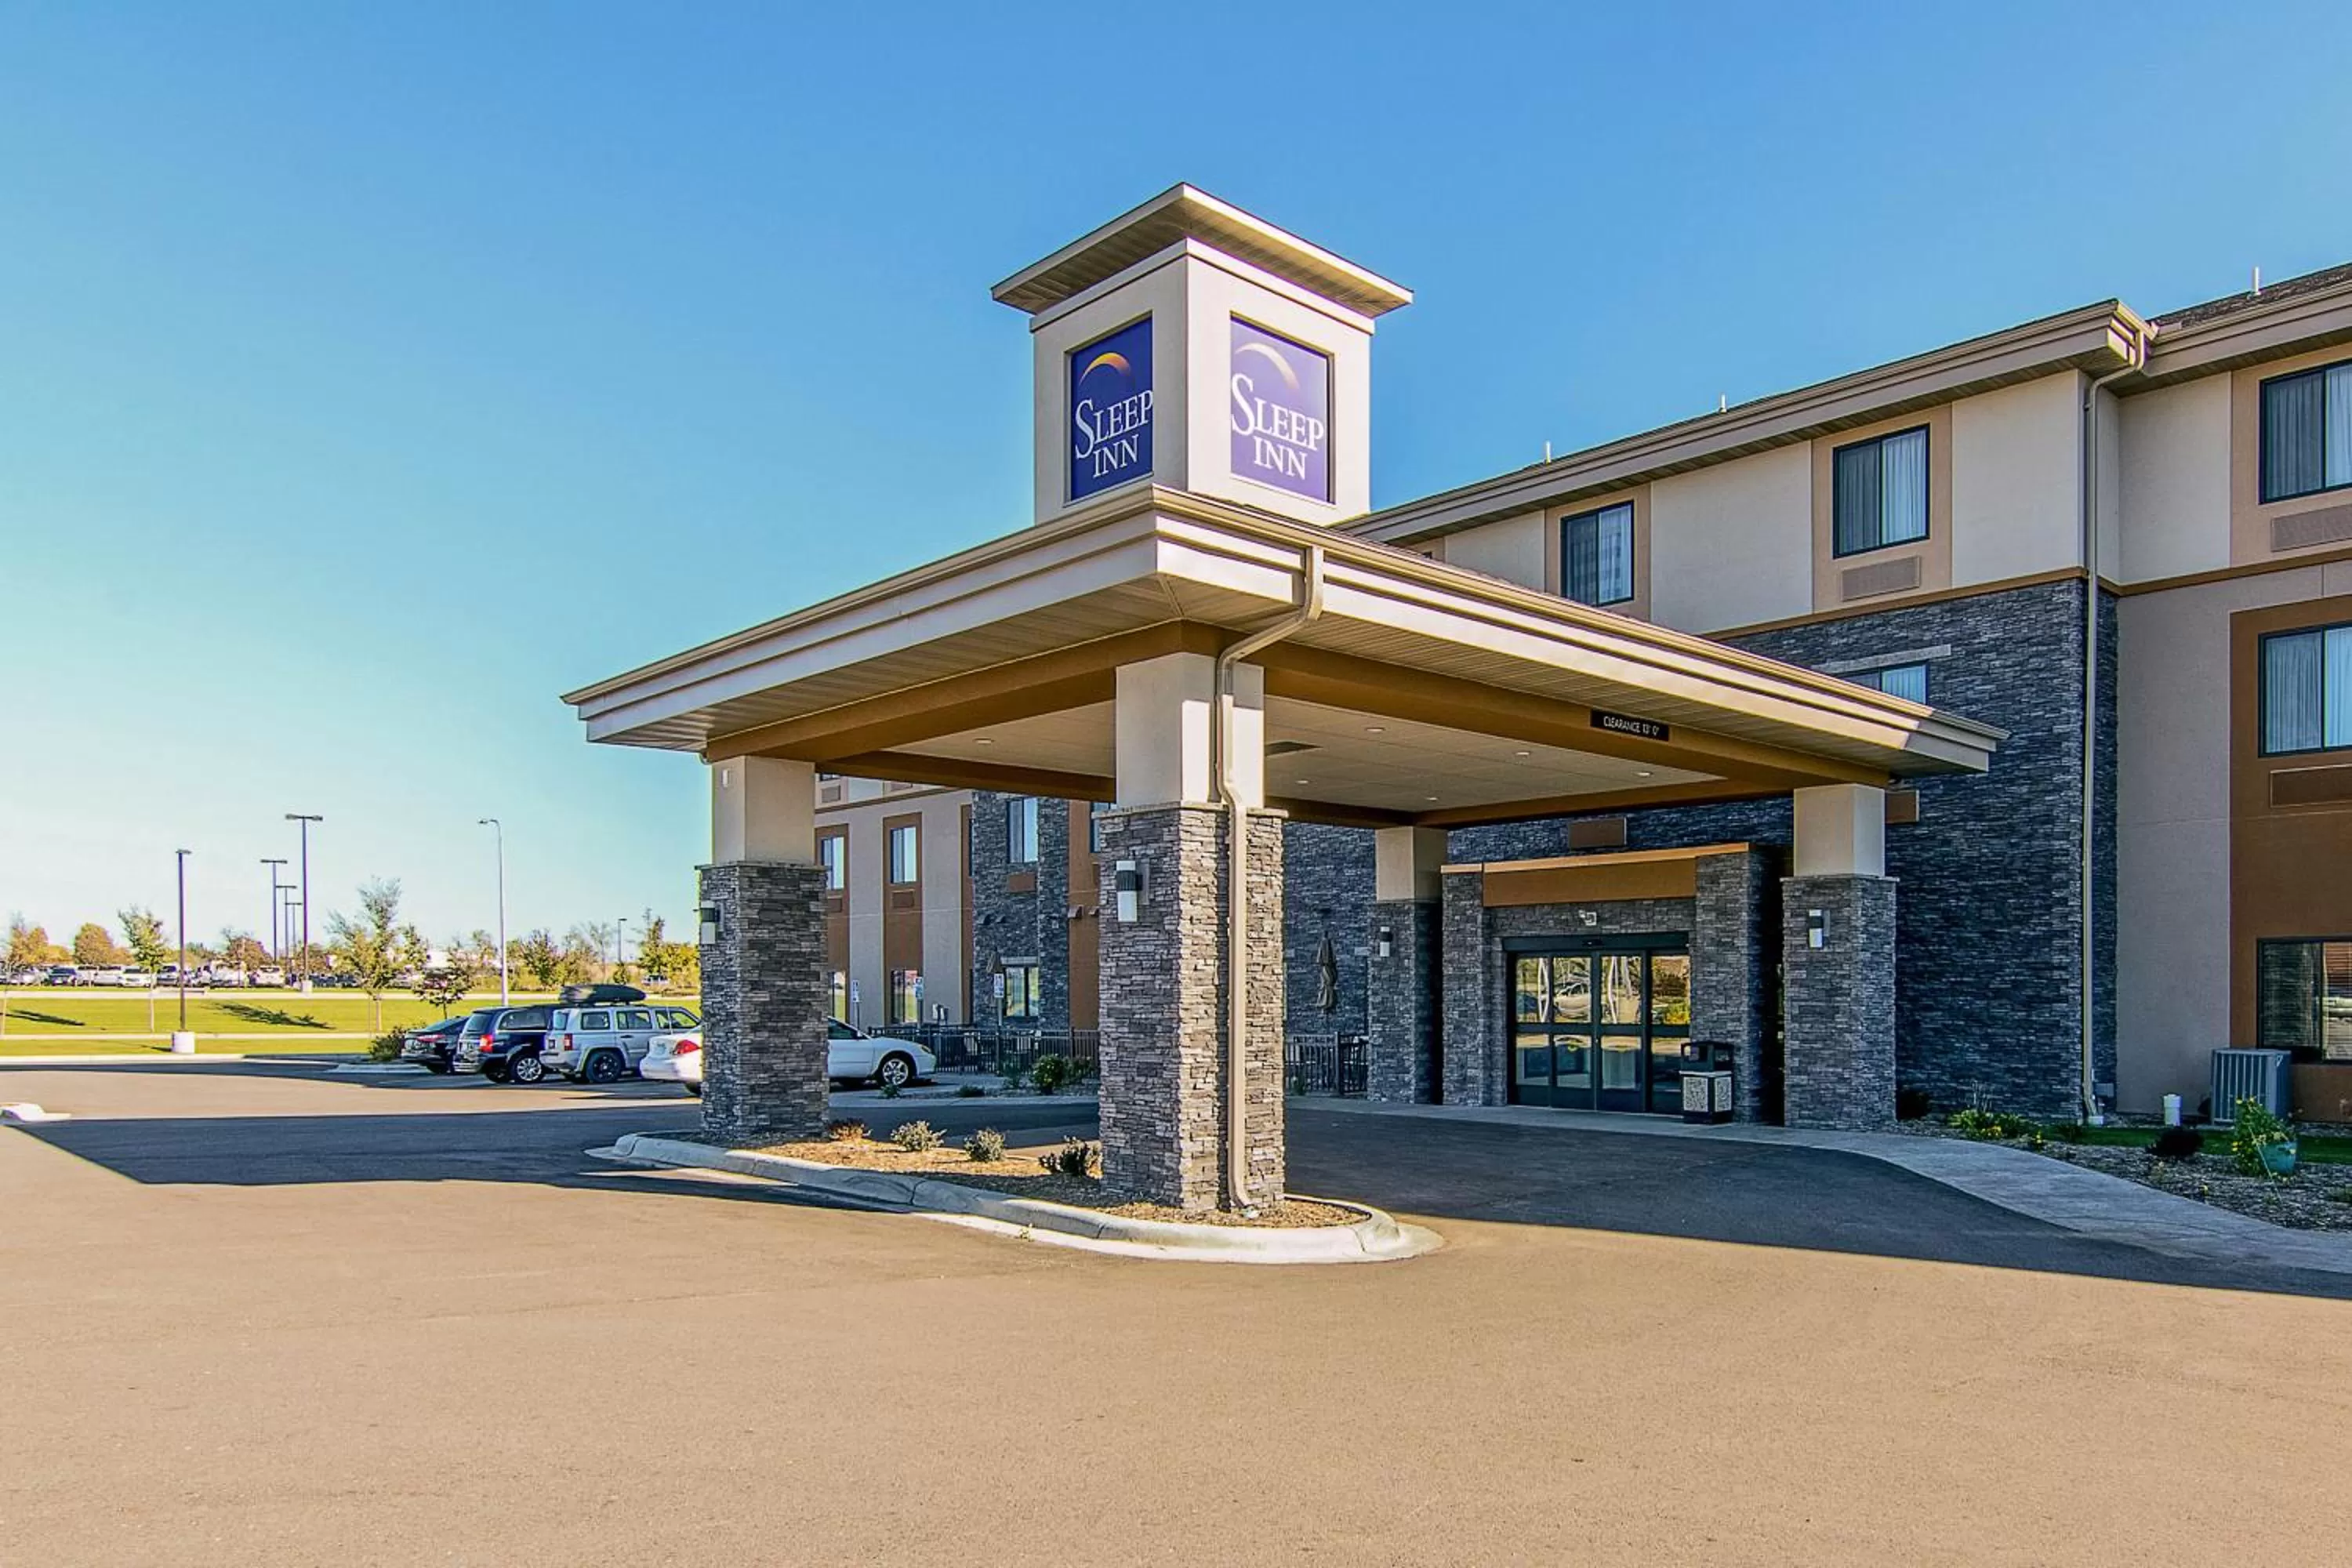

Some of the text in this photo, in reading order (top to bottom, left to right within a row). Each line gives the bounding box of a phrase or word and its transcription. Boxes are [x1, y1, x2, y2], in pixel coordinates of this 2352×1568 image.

[1075, 390, 1153, 459] SLEEP
[1231, 372, 1324, 452] SLEEP
[1093, 434, 1139, 478] INN
[1254, 436, 1308, 480] INN
[1603, 716, 1641, 733] CLEARANCE
